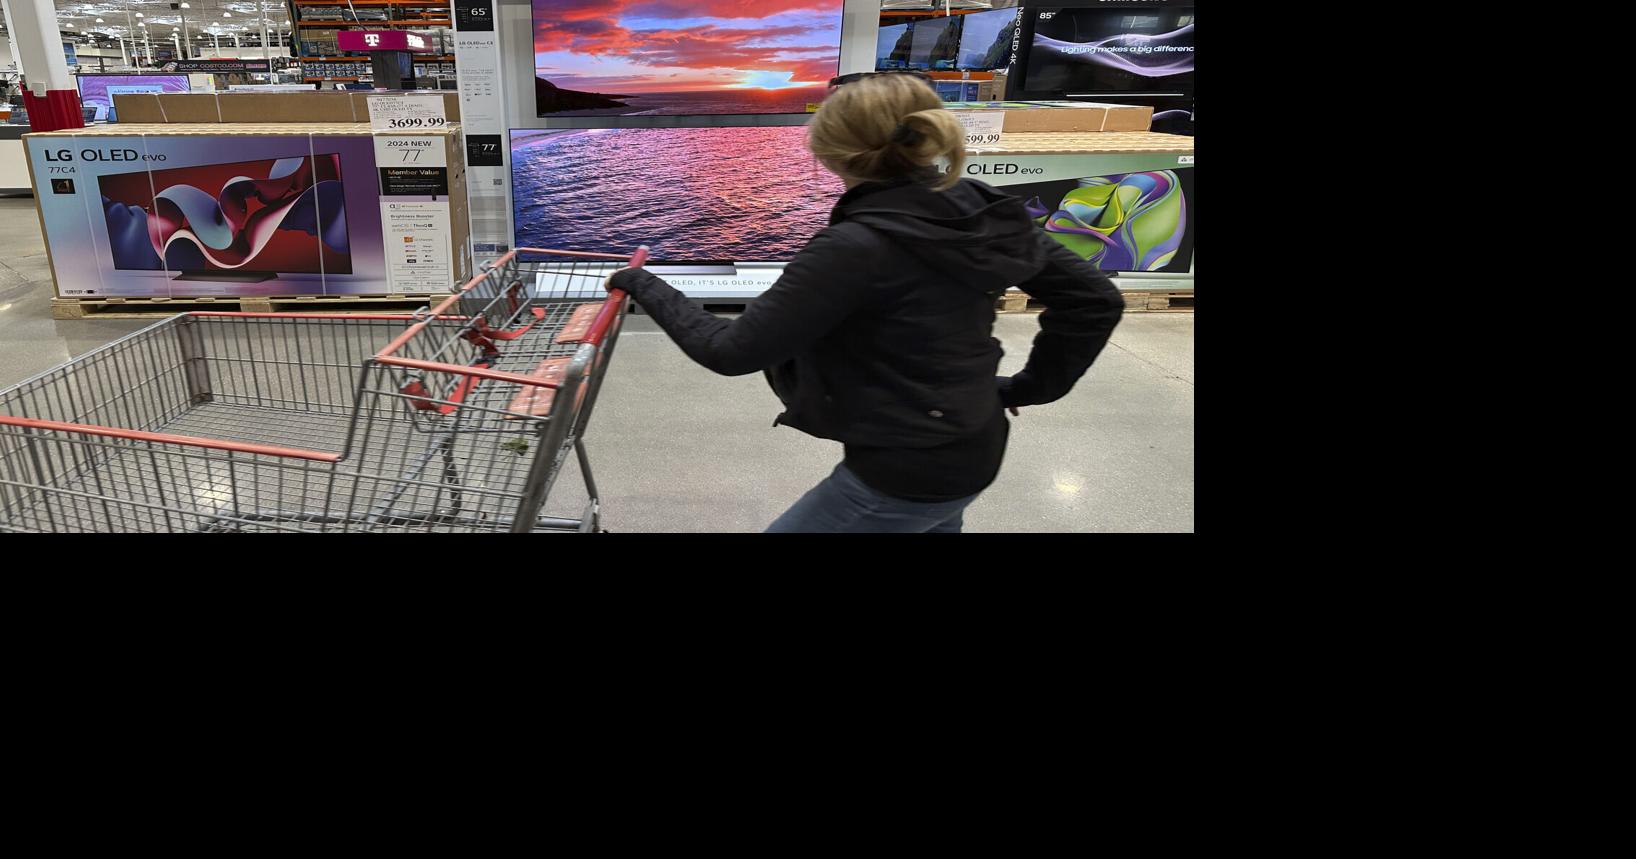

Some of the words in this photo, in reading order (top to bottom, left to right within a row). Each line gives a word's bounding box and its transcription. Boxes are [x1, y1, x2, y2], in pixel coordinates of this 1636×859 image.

[1015, 7, 1024, 26] Neo
[364, 34, 380, 46] T
[1012, 28, 1021, 50] QLED
[1061, 46, 1097, 54] Lighting
[1137, 46, 1152, 54] big
[1010, 53, 1017, 65] 4K
[389, 117, 445, 129] 3699.99
[44, 149, 73, 162] LG
[80, 149, 139, 162] OLED
[966, 163, 1019, 175] OLED
[1020, 167, 1044, 175] evo
[671, 279, 696, 287] OLED,
